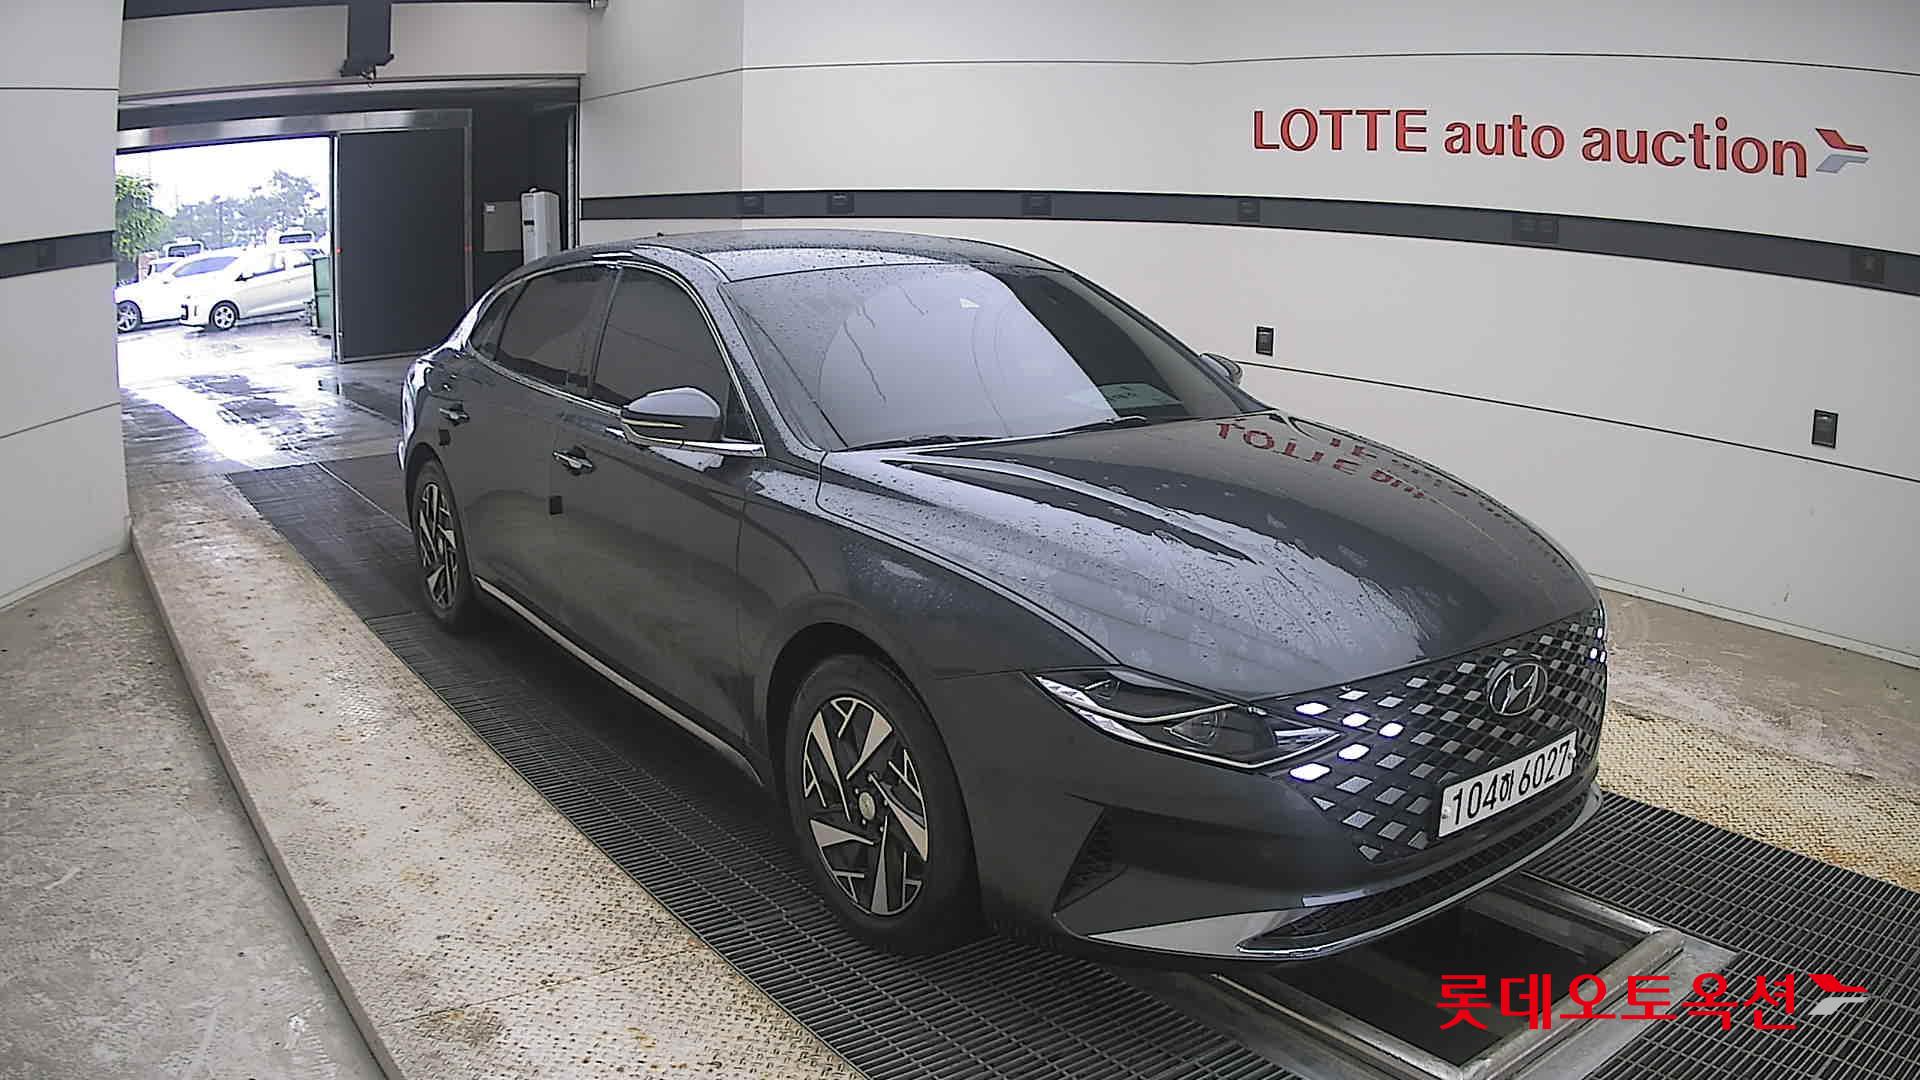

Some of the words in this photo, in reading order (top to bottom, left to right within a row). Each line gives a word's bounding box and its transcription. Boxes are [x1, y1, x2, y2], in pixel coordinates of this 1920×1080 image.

[1253, 107, 1428, 153] LOTTE
[1444, 114, 1565, 160] auto
[1581, 116, 1808, 178] auction
[1518, 739, 1571, 796] 6027
